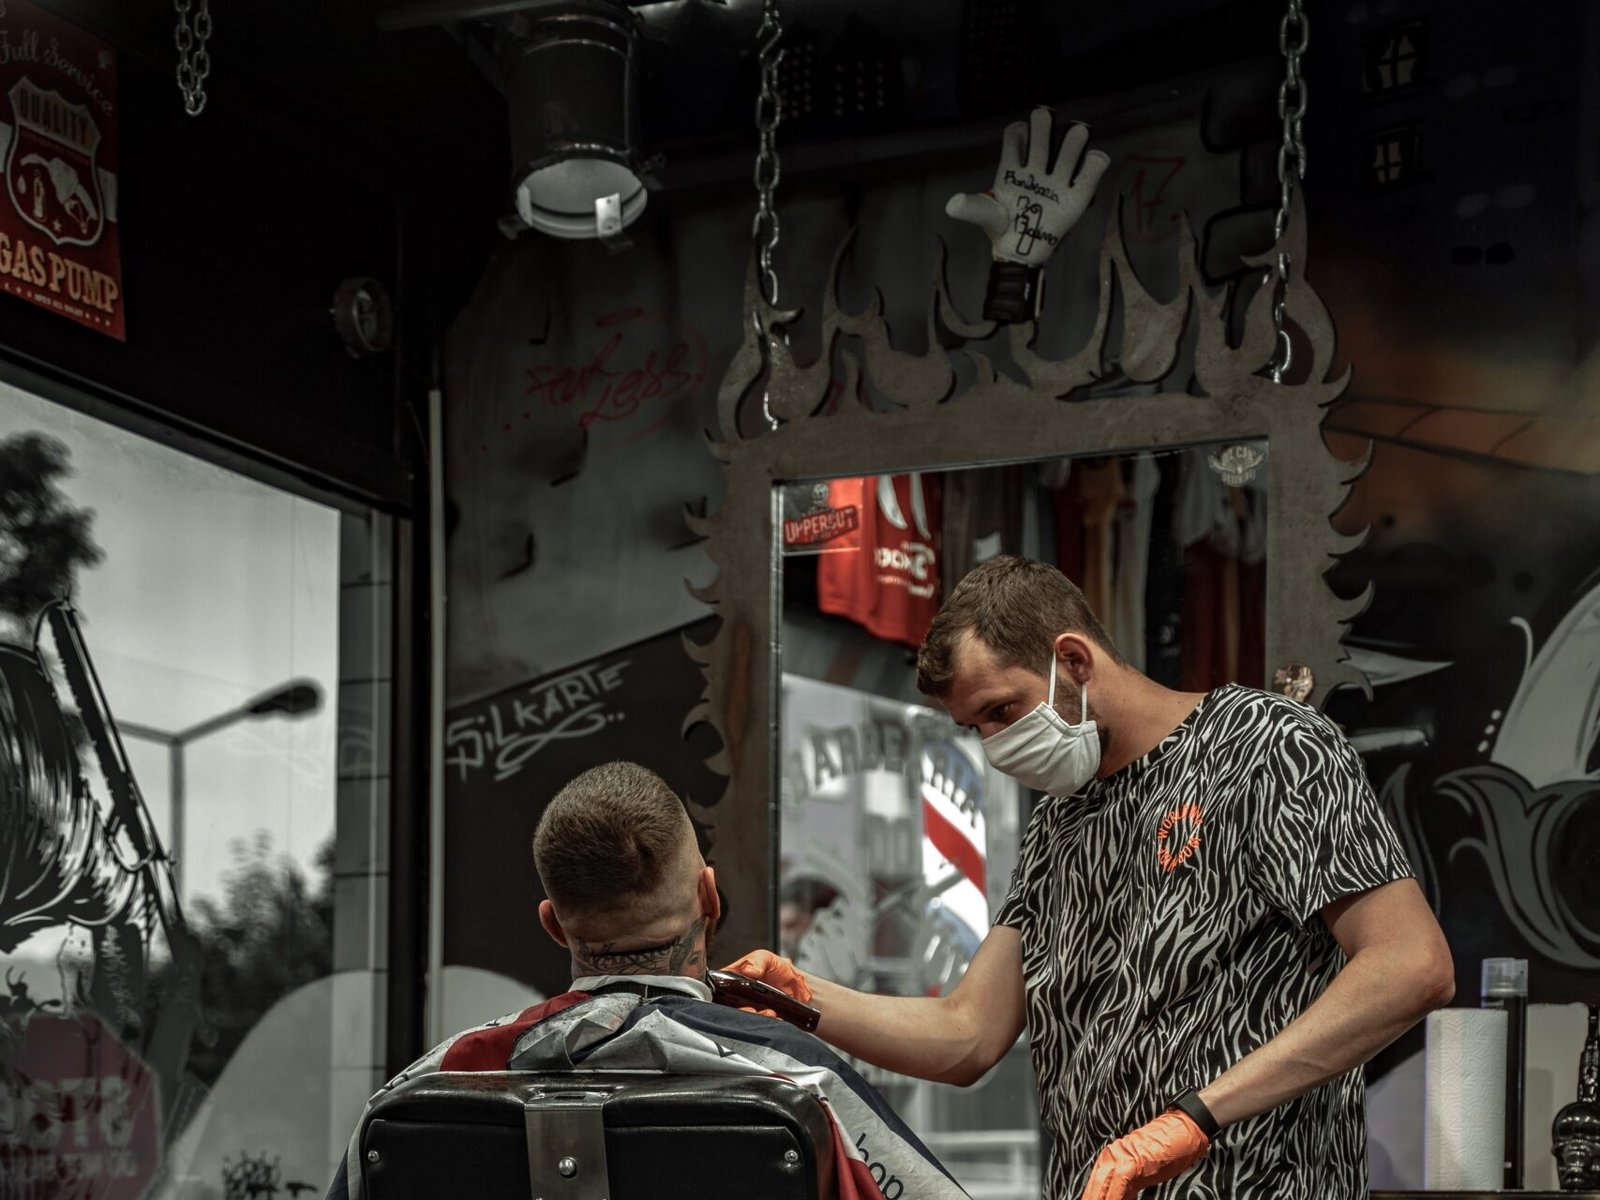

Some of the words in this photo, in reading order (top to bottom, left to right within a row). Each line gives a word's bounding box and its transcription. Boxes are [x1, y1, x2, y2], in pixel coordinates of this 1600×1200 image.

[42, 36, 113, 117] Service
[20, 87, 90, 147] QUALITY
[0, 231, 47, 288] GAS
[48, 251, 119, 314] PUMP
[784, 507, 854, 544] UPPERCUT
